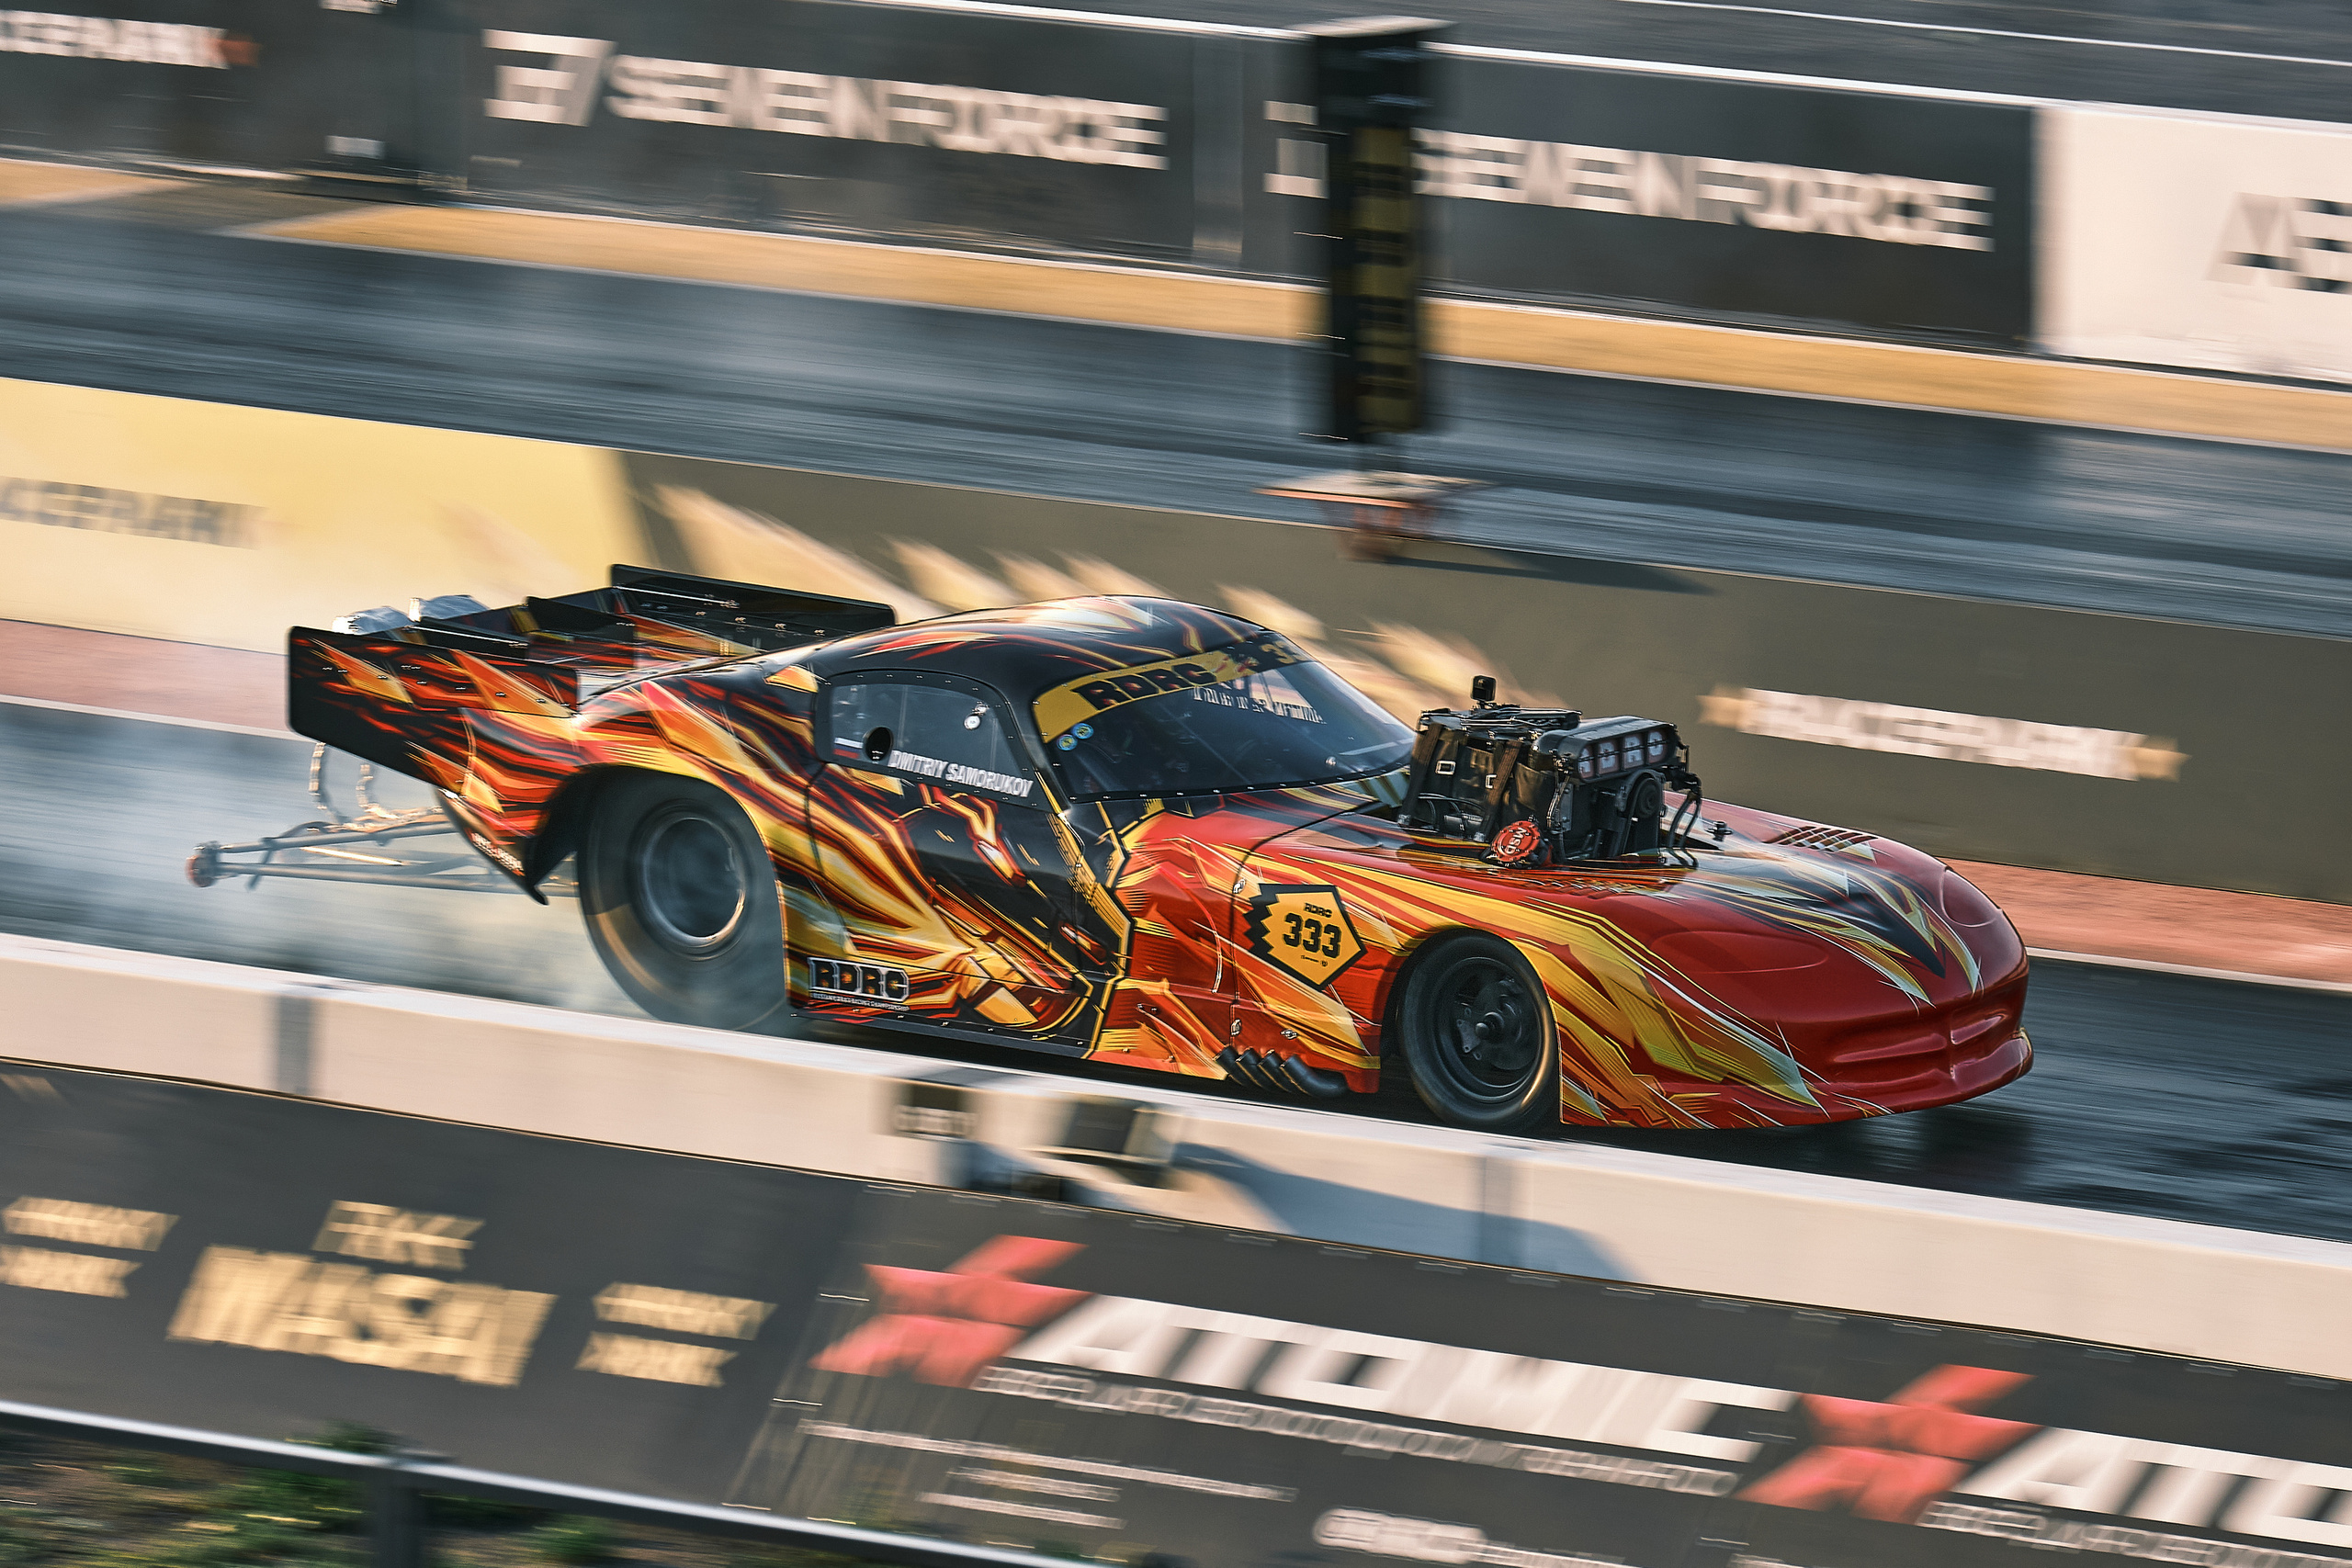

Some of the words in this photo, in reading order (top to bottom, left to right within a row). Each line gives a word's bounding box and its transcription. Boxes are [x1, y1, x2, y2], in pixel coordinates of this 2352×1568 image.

[1071, 662, 1216, 712] RDRC
[1505, 827, 1527, 854] MSD
[1304, 902, 1333, 919] RDRC
[1283, 912, 1342, 959] 333
[808, 956, 910, 1003] RDRC
[1006, 1293, 1803, 1463] ATOMIC
